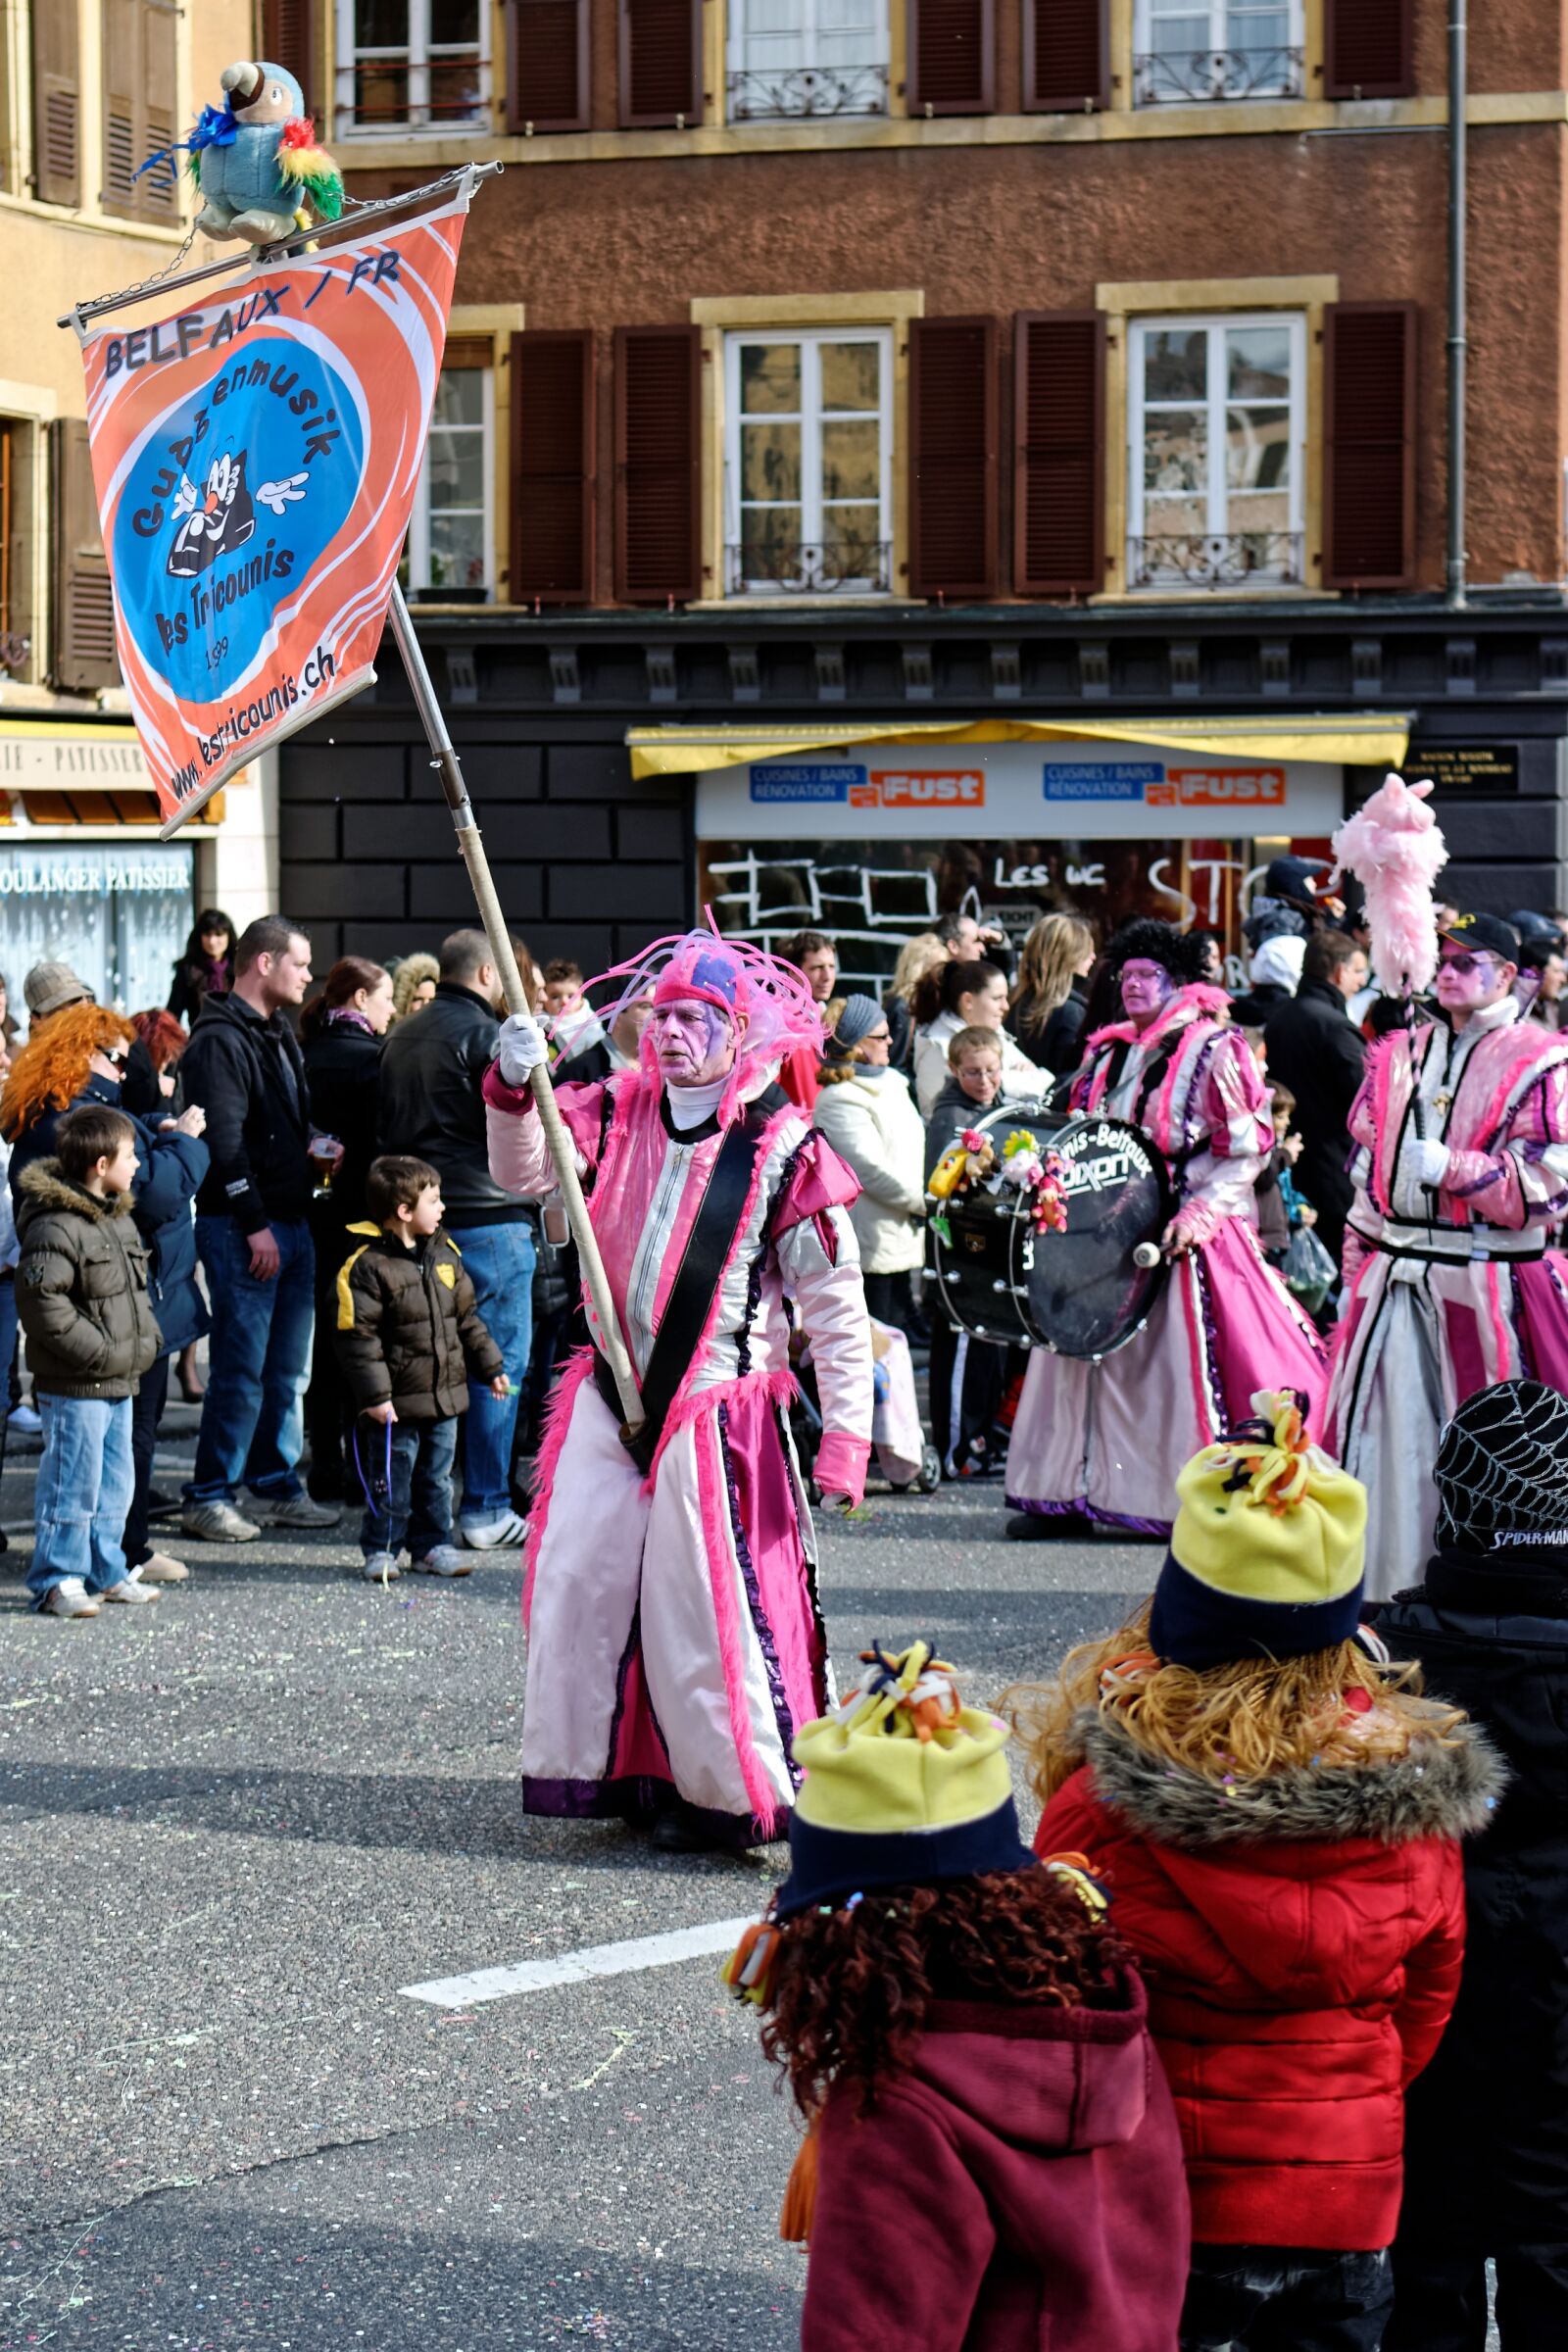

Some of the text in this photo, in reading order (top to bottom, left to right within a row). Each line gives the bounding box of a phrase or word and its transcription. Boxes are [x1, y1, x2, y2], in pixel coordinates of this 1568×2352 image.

[105, 284, 290, 379] BELFAUX
[346, 250, 402, 295] FR
[190, 538, 295, 630] Tricounis
[753, 767, 811, 783] CUISINES
[819, 767, 858, 782] BAINS
[1048, 765, 1105, 781] CUISINES
[1115, 765, 1155, 780] BAINS
[754, 782, 836, 798] RÉNOVATION
[1048, 780, 1133, 796] RÉNOVATION
[106, 865, 190, 891] PATISSIER
